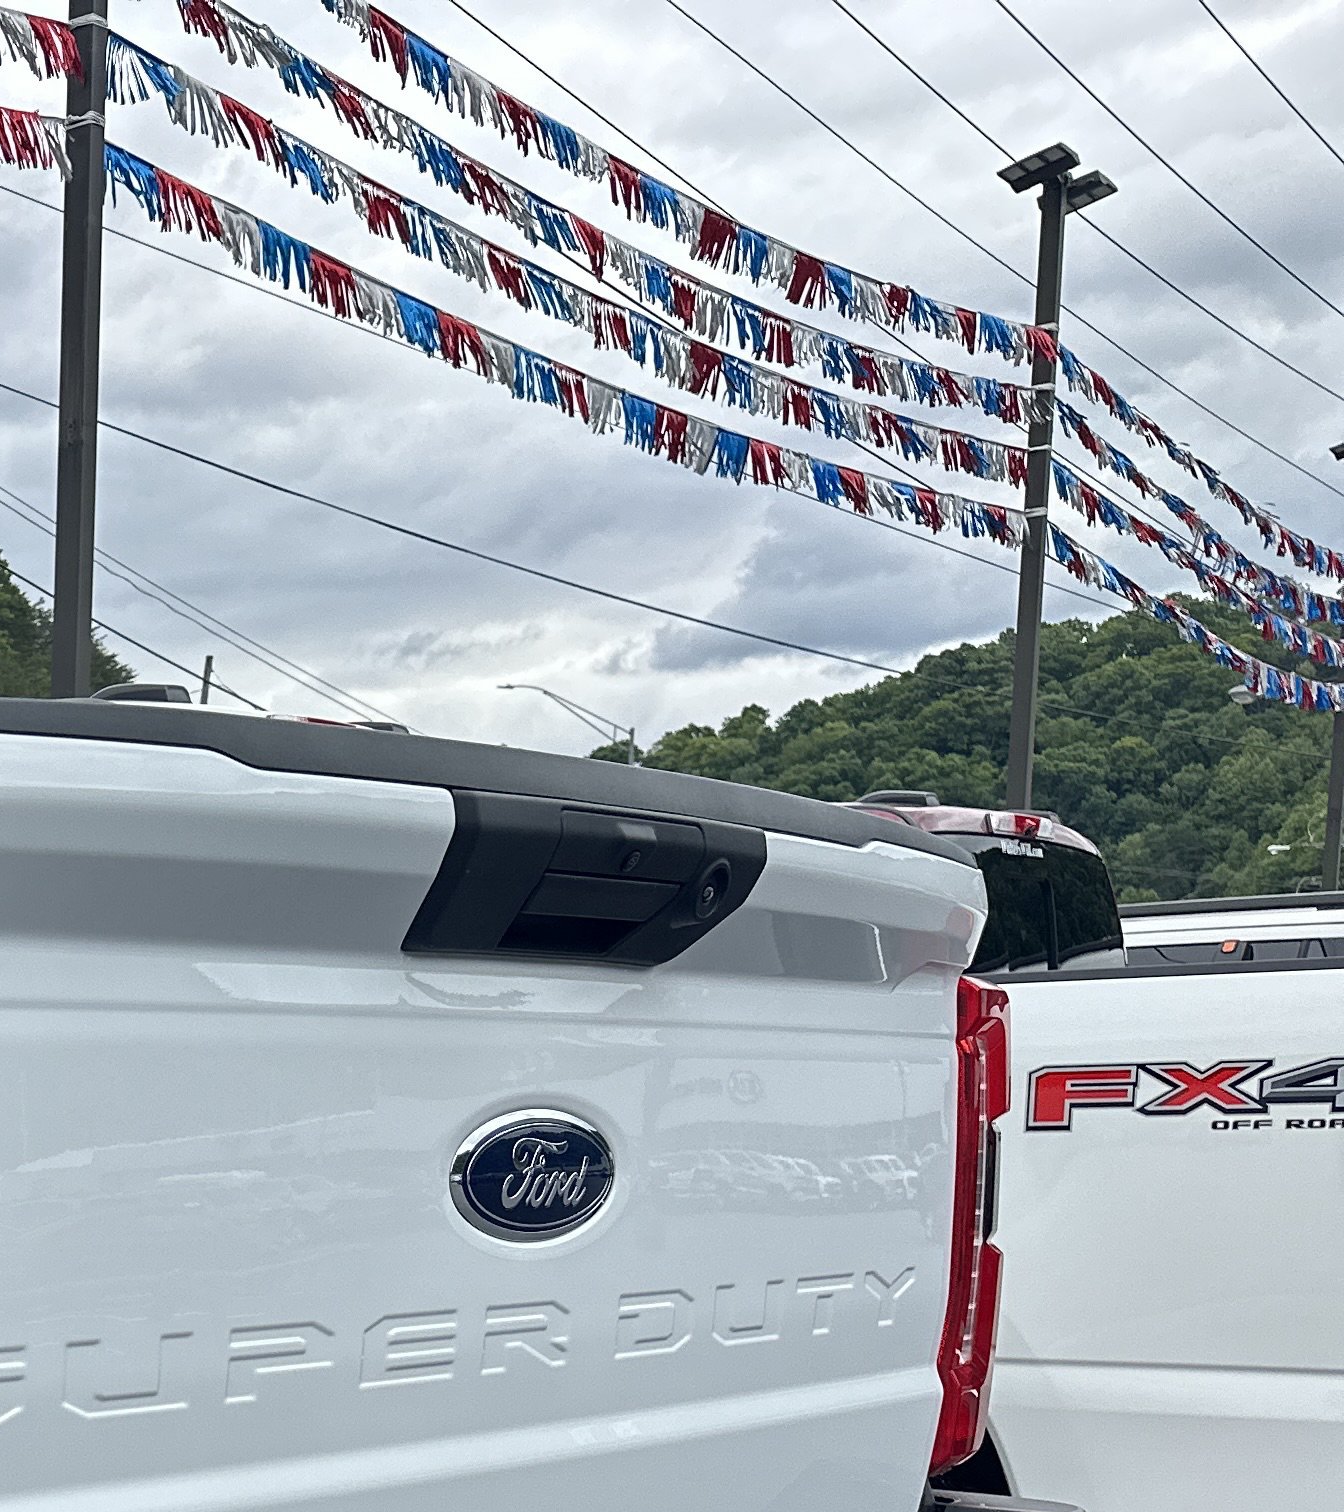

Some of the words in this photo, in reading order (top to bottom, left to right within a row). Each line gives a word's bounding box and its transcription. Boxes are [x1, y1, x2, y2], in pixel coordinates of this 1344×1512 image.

[1025, 1057, 1344, 1132] FX4
[1211, 1118, 1274, 1131] OFF
[1285, 1118, 1344, 1130] ROA
[501, 1137, 590, 1210] Ford
[614, 1266, 916, 1360] DUTY
